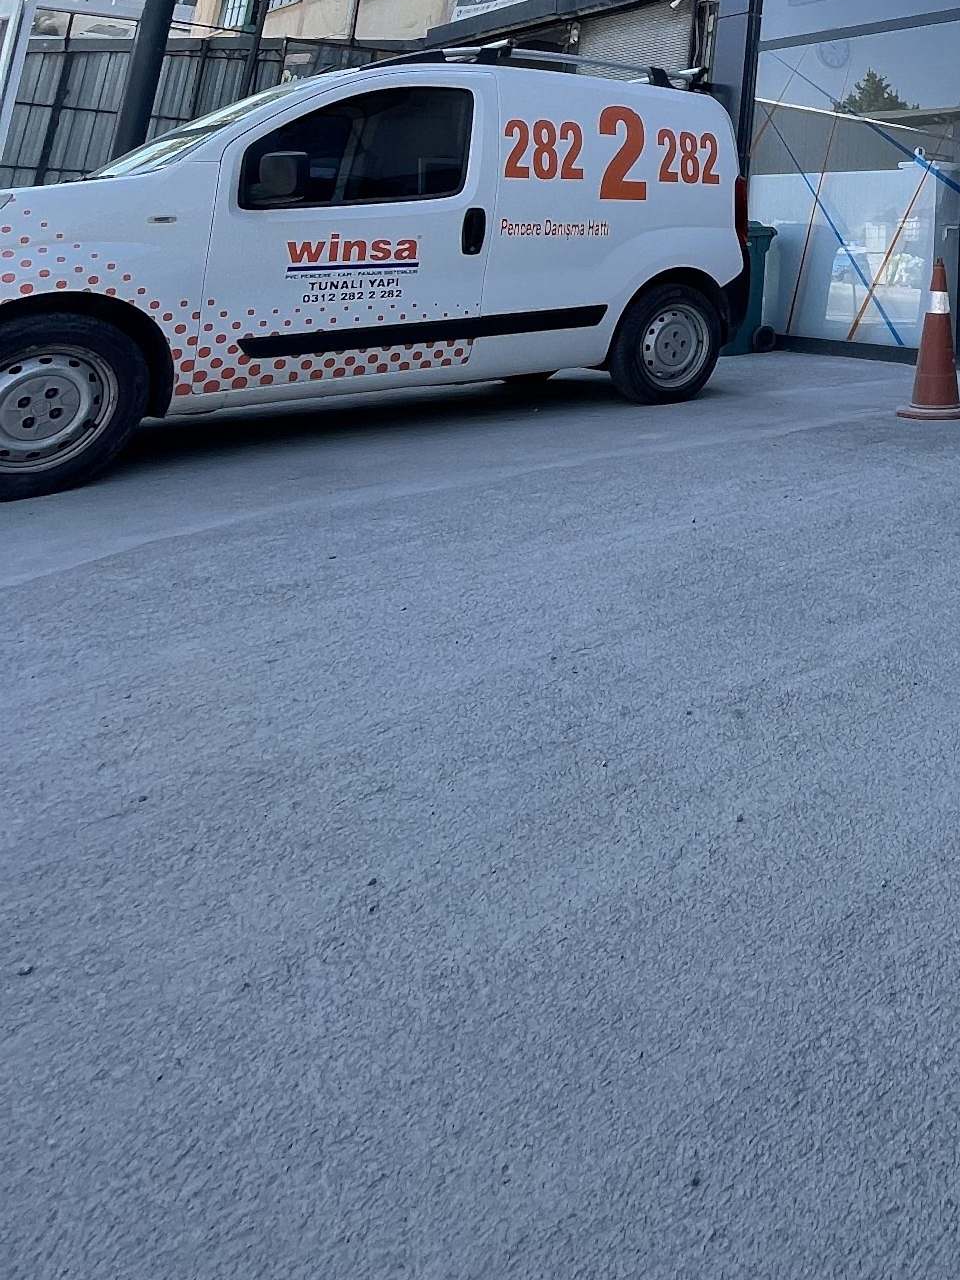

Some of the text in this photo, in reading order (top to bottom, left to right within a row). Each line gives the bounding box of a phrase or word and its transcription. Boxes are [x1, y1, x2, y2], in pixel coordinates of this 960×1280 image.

[504, 105, 720, 201] 282 2 282
[500, 219, 610, 240] Pencere Danışma Hattı
[287, 233, 418, 263] winsa
[309, 277, 400, 291] TUNALI YAPI
[302, 289, 402, 303] 0312 282 2 282
